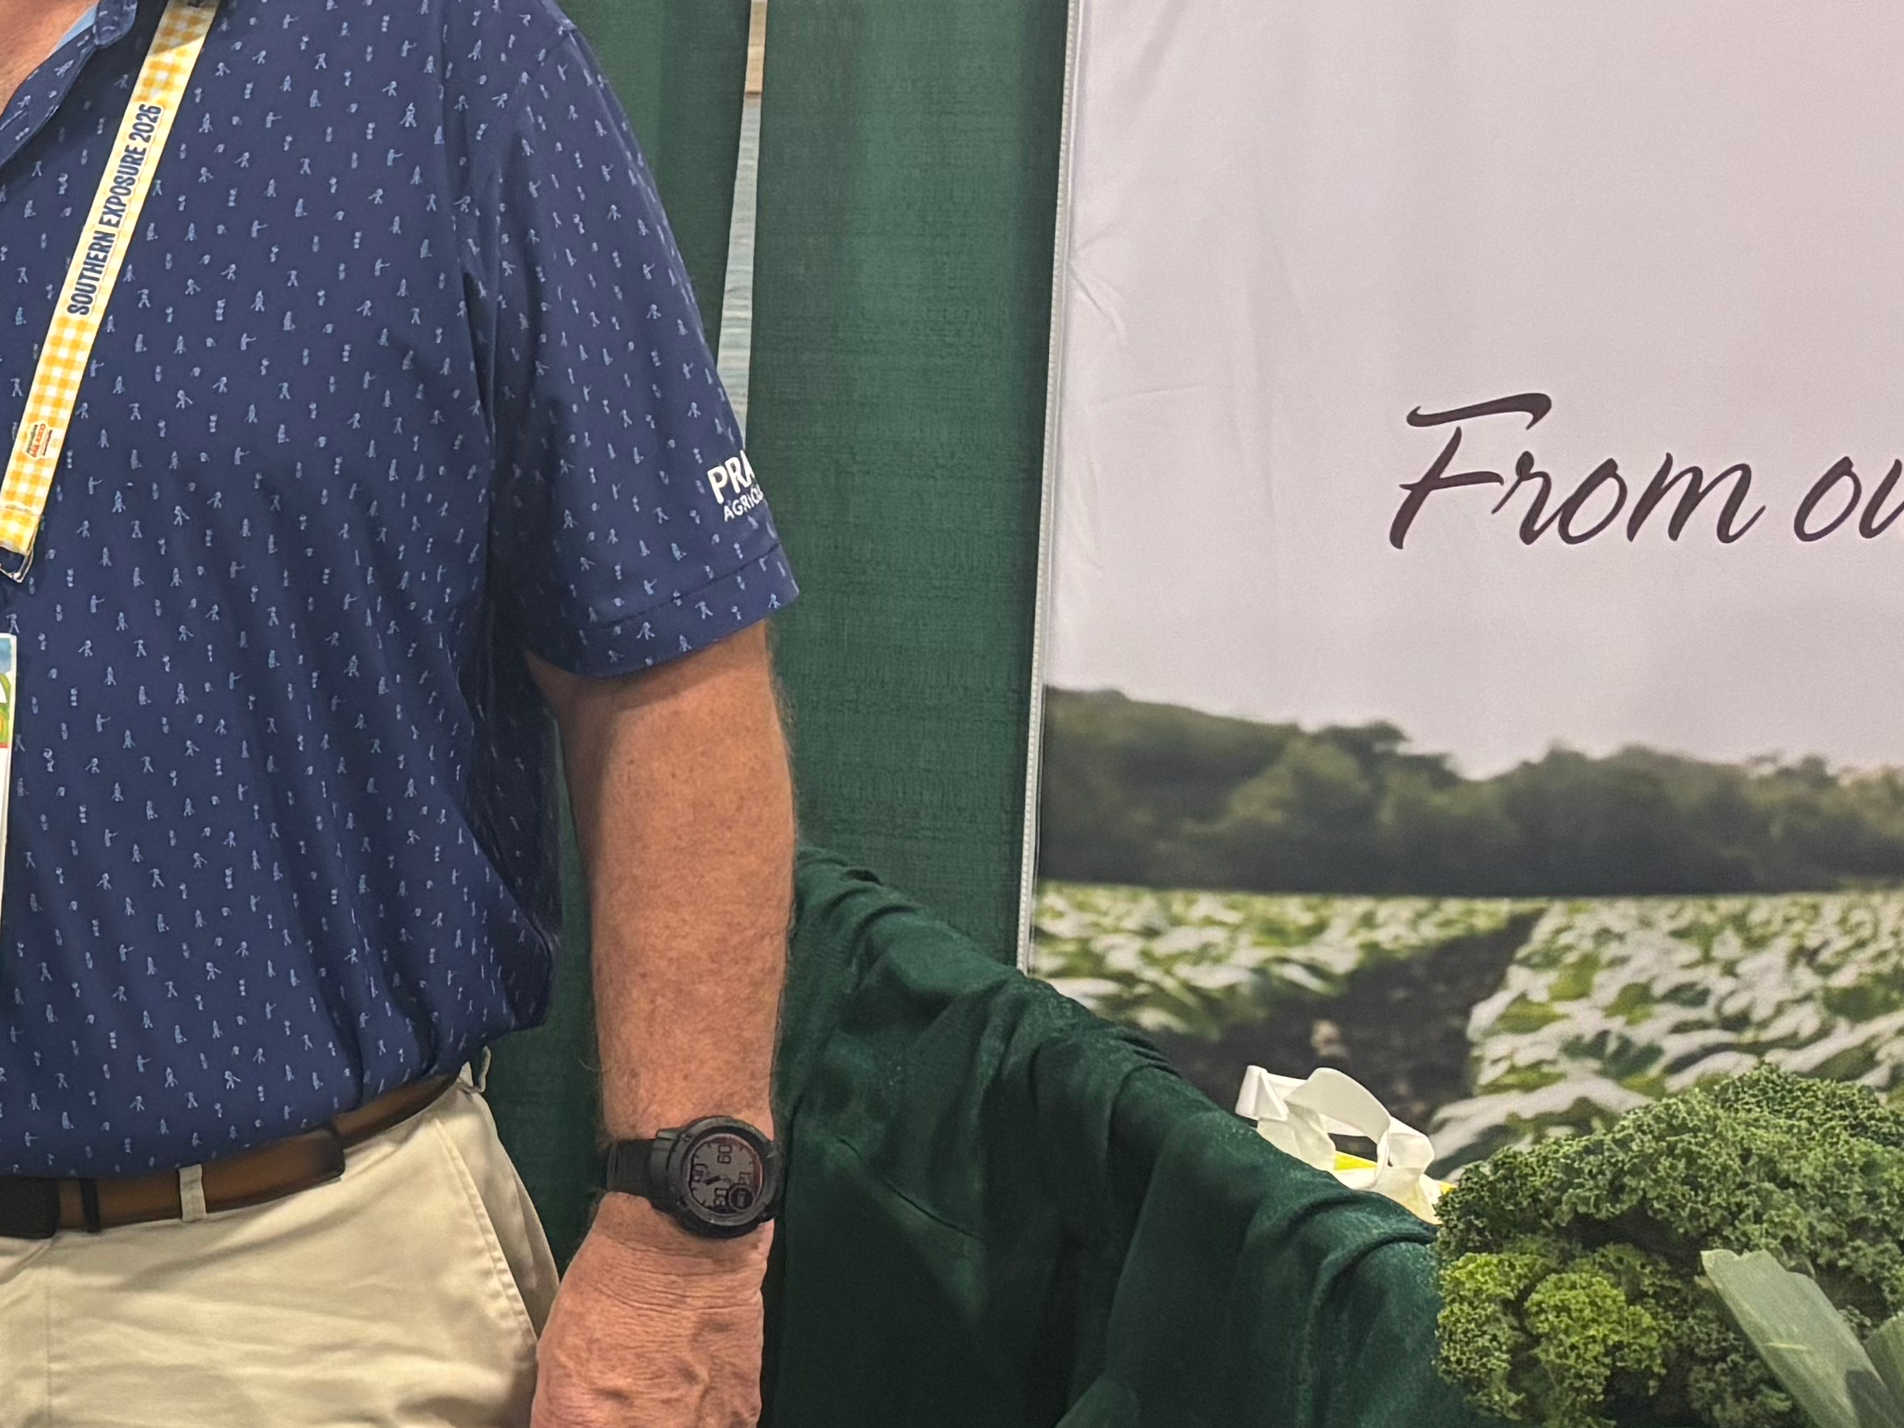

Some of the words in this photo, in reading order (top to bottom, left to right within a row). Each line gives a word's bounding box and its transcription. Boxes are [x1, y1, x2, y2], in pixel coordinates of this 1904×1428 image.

[67, 229, 117, 315] SOUTHERN
[96, 145, 144, 230] EXPOSURE
[131, 103, 164, 147] 2026
[1389, 392, 1766, 550] From
